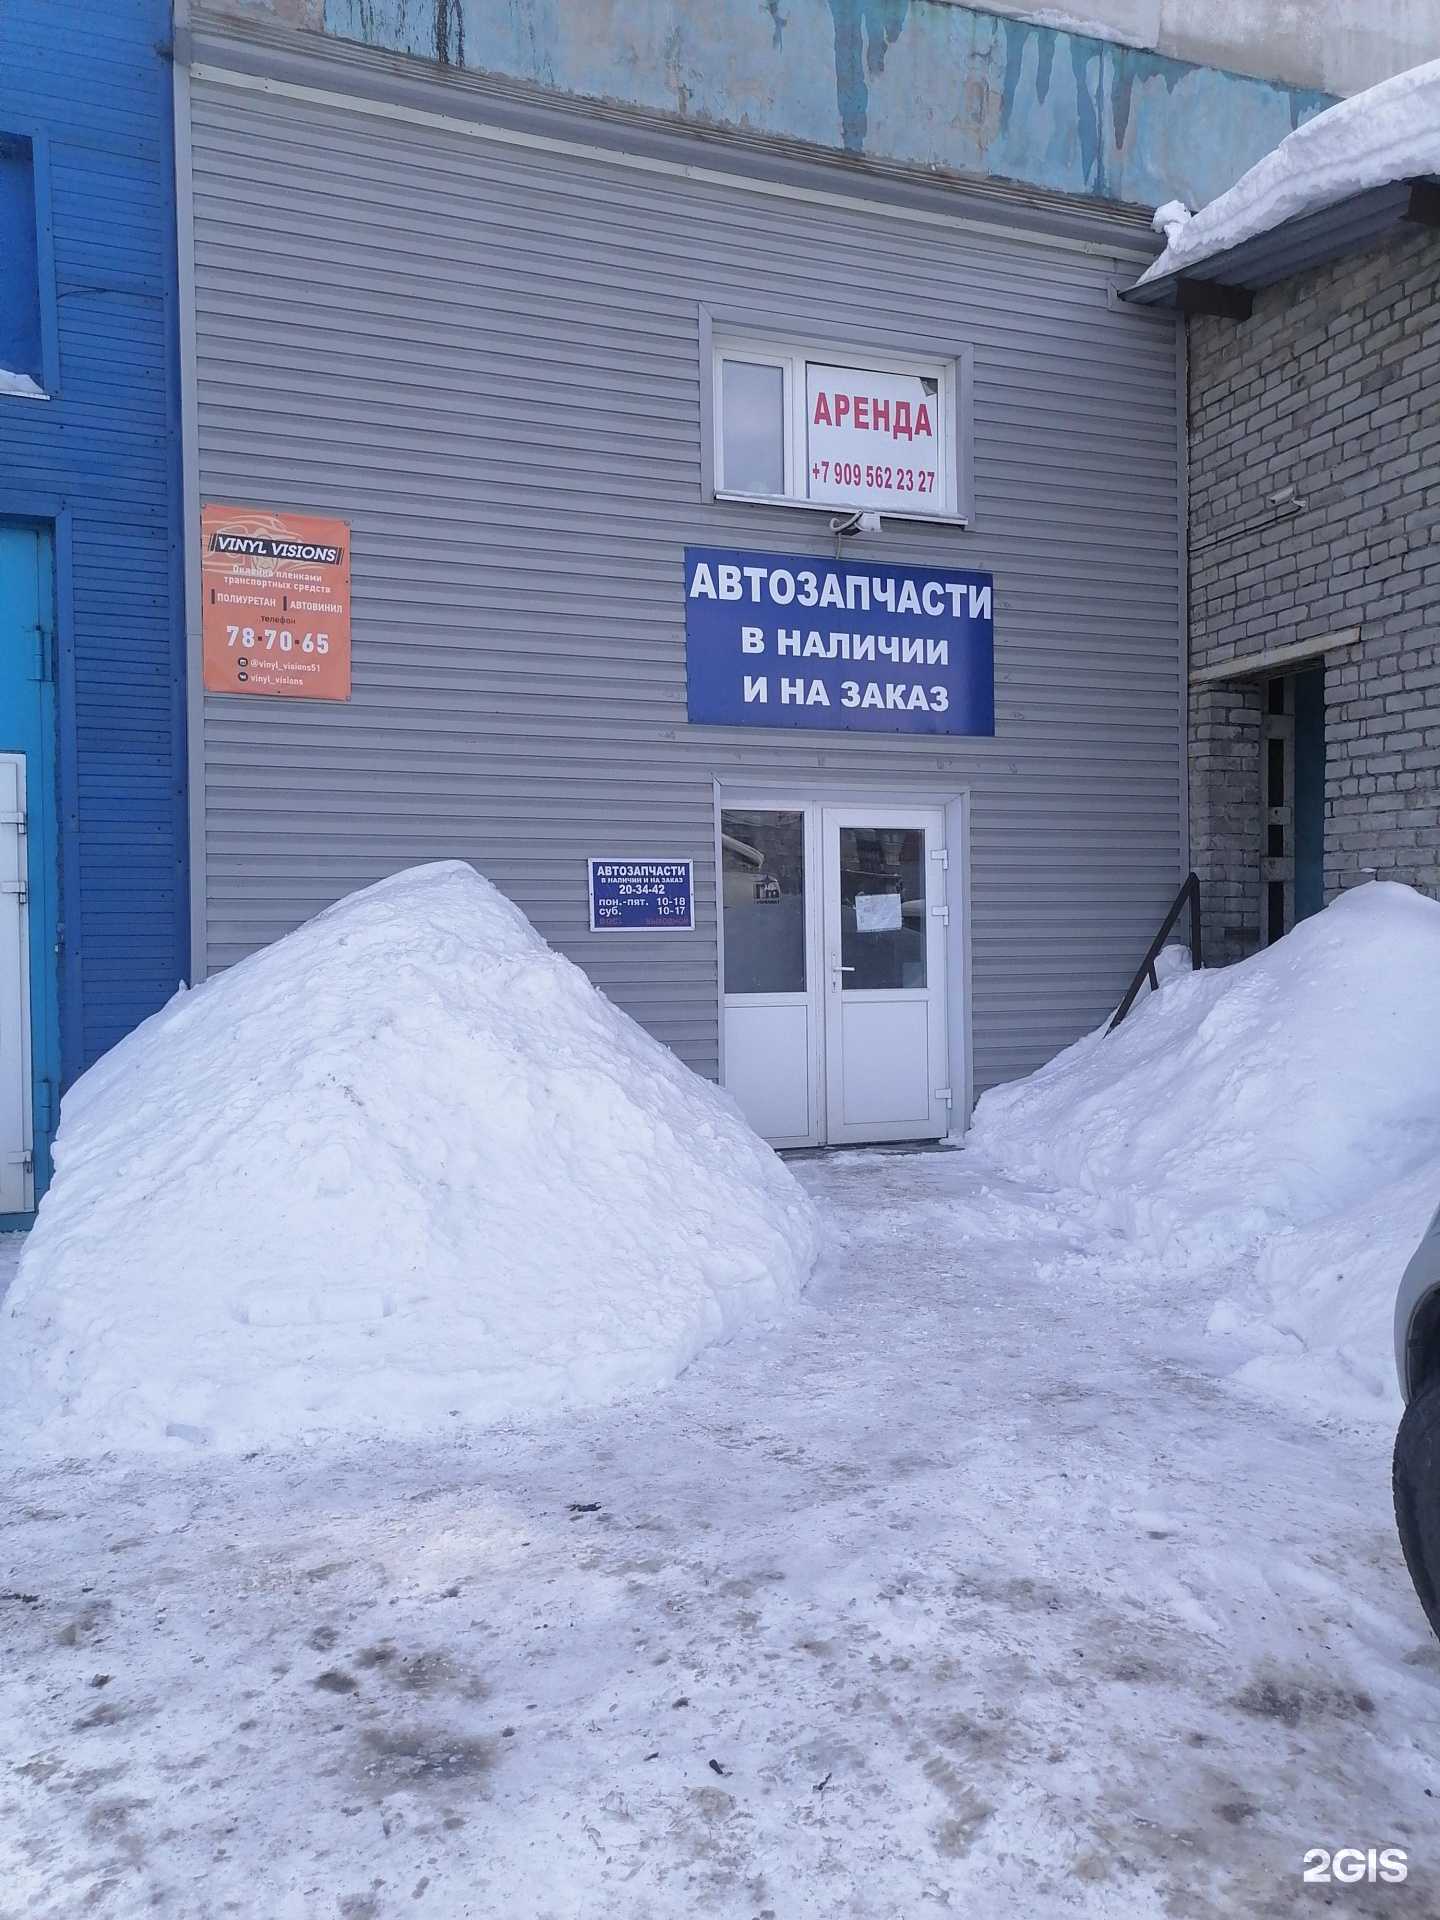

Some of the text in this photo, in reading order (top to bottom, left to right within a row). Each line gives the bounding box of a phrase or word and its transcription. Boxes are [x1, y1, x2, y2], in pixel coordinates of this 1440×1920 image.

[814, 392, 933, 441] АРЕНДА
[834, 462, 861, 486] 909
[866, 465, 892, 489] 562
[896, 468, 914, 491] 23
[918, 470, 935, 493] 27
[218, 536, 337, 562] VINYL VISIONS
[293, 582, 331, 594] средств
[689, 563, 992, 620] АВТОЗАПЧАСТИ
[217, 592, 343, 615] ПОЛИУРЕТАН АВТОВИНИЛ
[742, 627, 949, 666] В НАЛИЧИИ
[744, 676, 950, 712] И НА ЗАКАЗ
[597, 866, 686, 876] АВТОЗАПЧАСТИ
[619, 884, 666, 895] 20-34-42
[657, 897, 686, 906] 10-18
[599, 906, 686, 917] суб. 10-17
